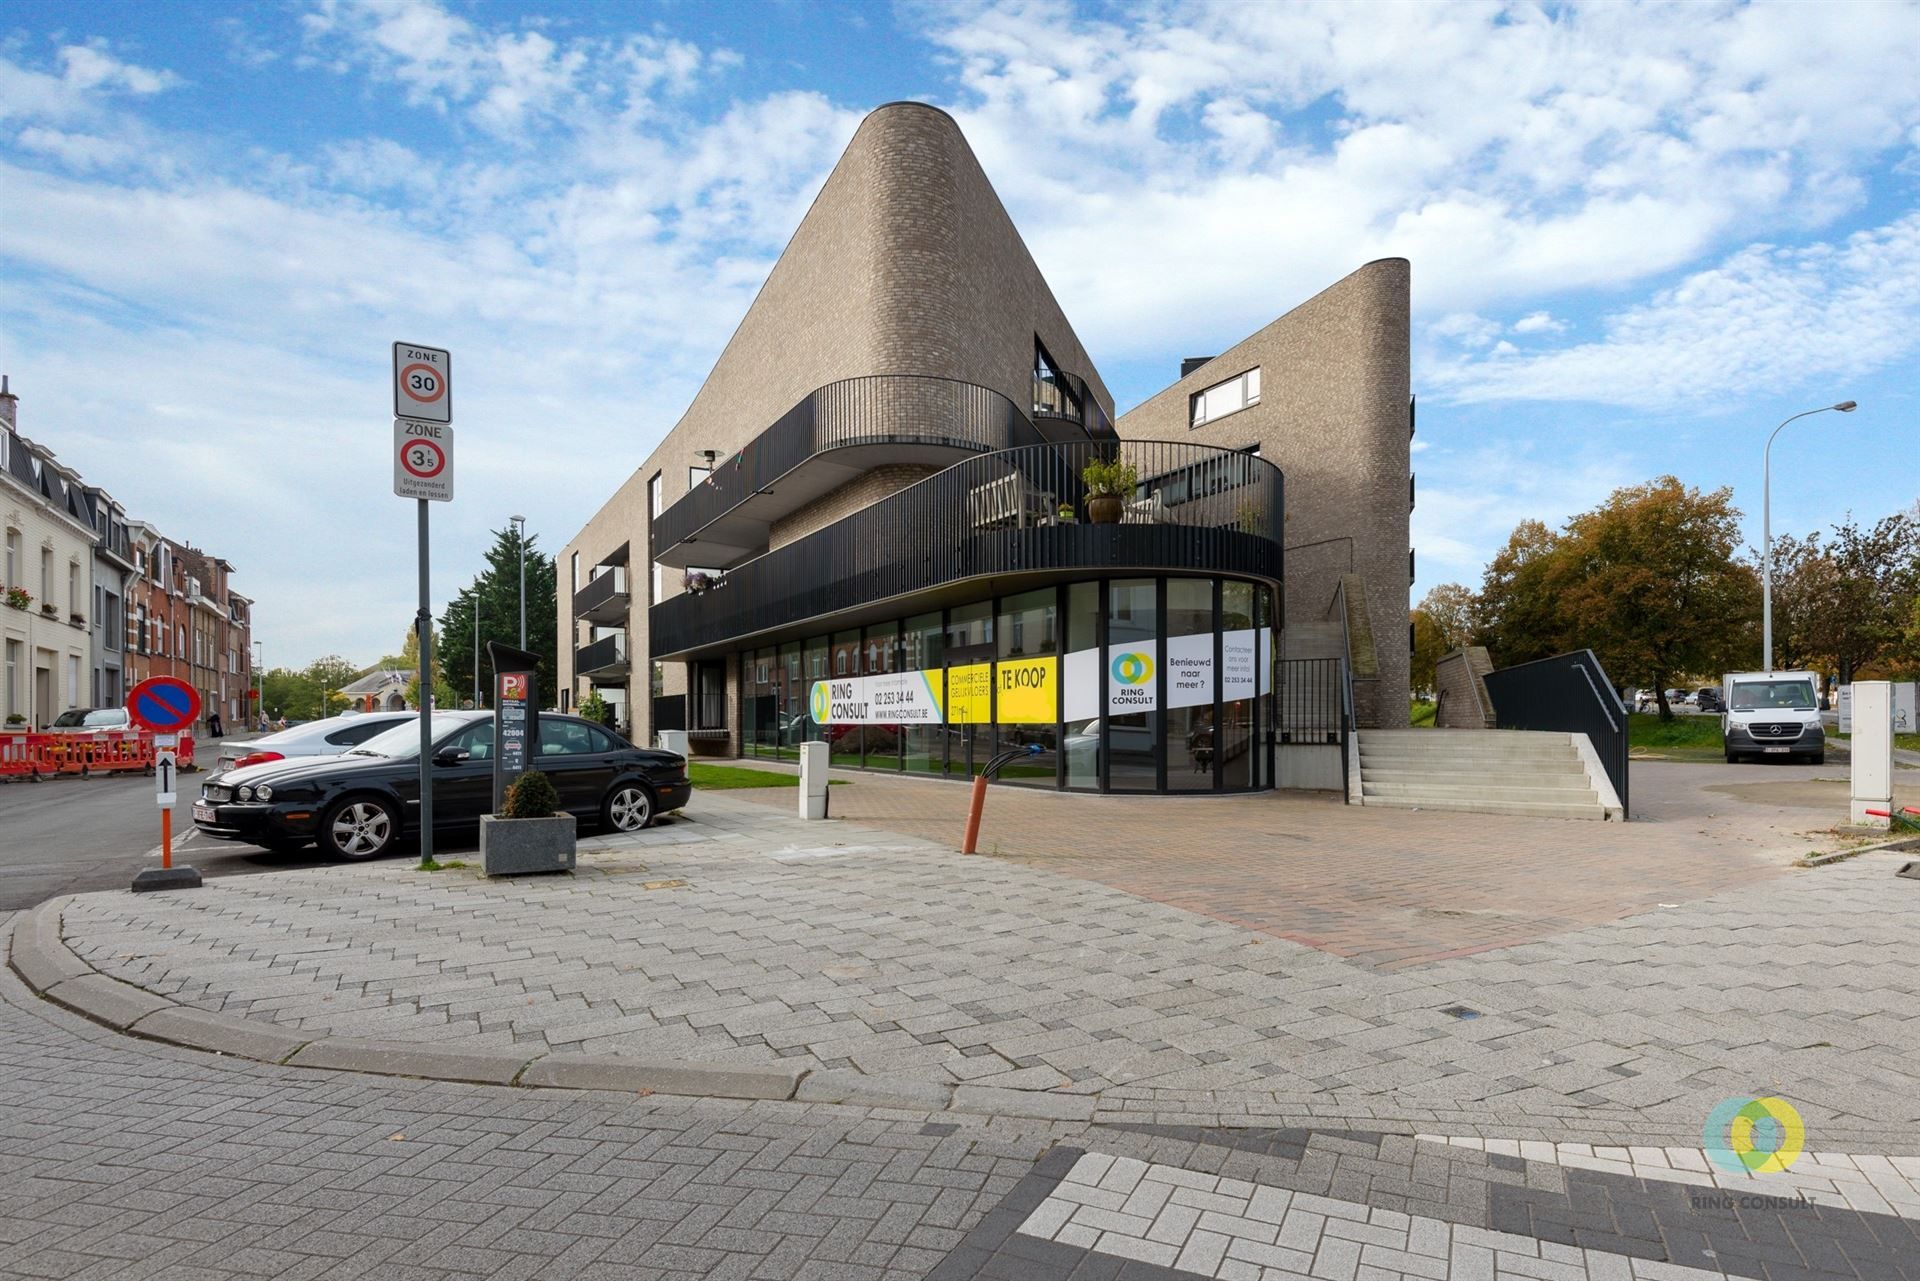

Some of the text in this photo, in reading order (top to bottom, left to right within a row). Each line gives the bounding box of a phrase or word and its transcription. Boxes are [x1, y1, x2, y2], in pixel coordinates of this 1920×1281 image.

[407, 350, 438, 362] ZONE
[411, 375, 435, 391] 30
[405, 423, 442, 438] ZONE
[403, 478, 445, 489] Uitgezonderd
[399, 486, 417, 495] laden
[428, 490, 449, 499] lossen
[1170, 658, 1212, 667] Benieuwd
[1002, 666, 1046, 690] TE KOOP
[1180, 670, 1201, 678] naar
[1176, 680, 1198, 688] meer
[831, 682, 852, 700] RING
[875, 690, 914, 706] 02 253 34 44
[1112, 697, 1153, 705] CONSULT
[831, 702, 869, 719] CONSULT
[502, 729, 524, 737] 42004
